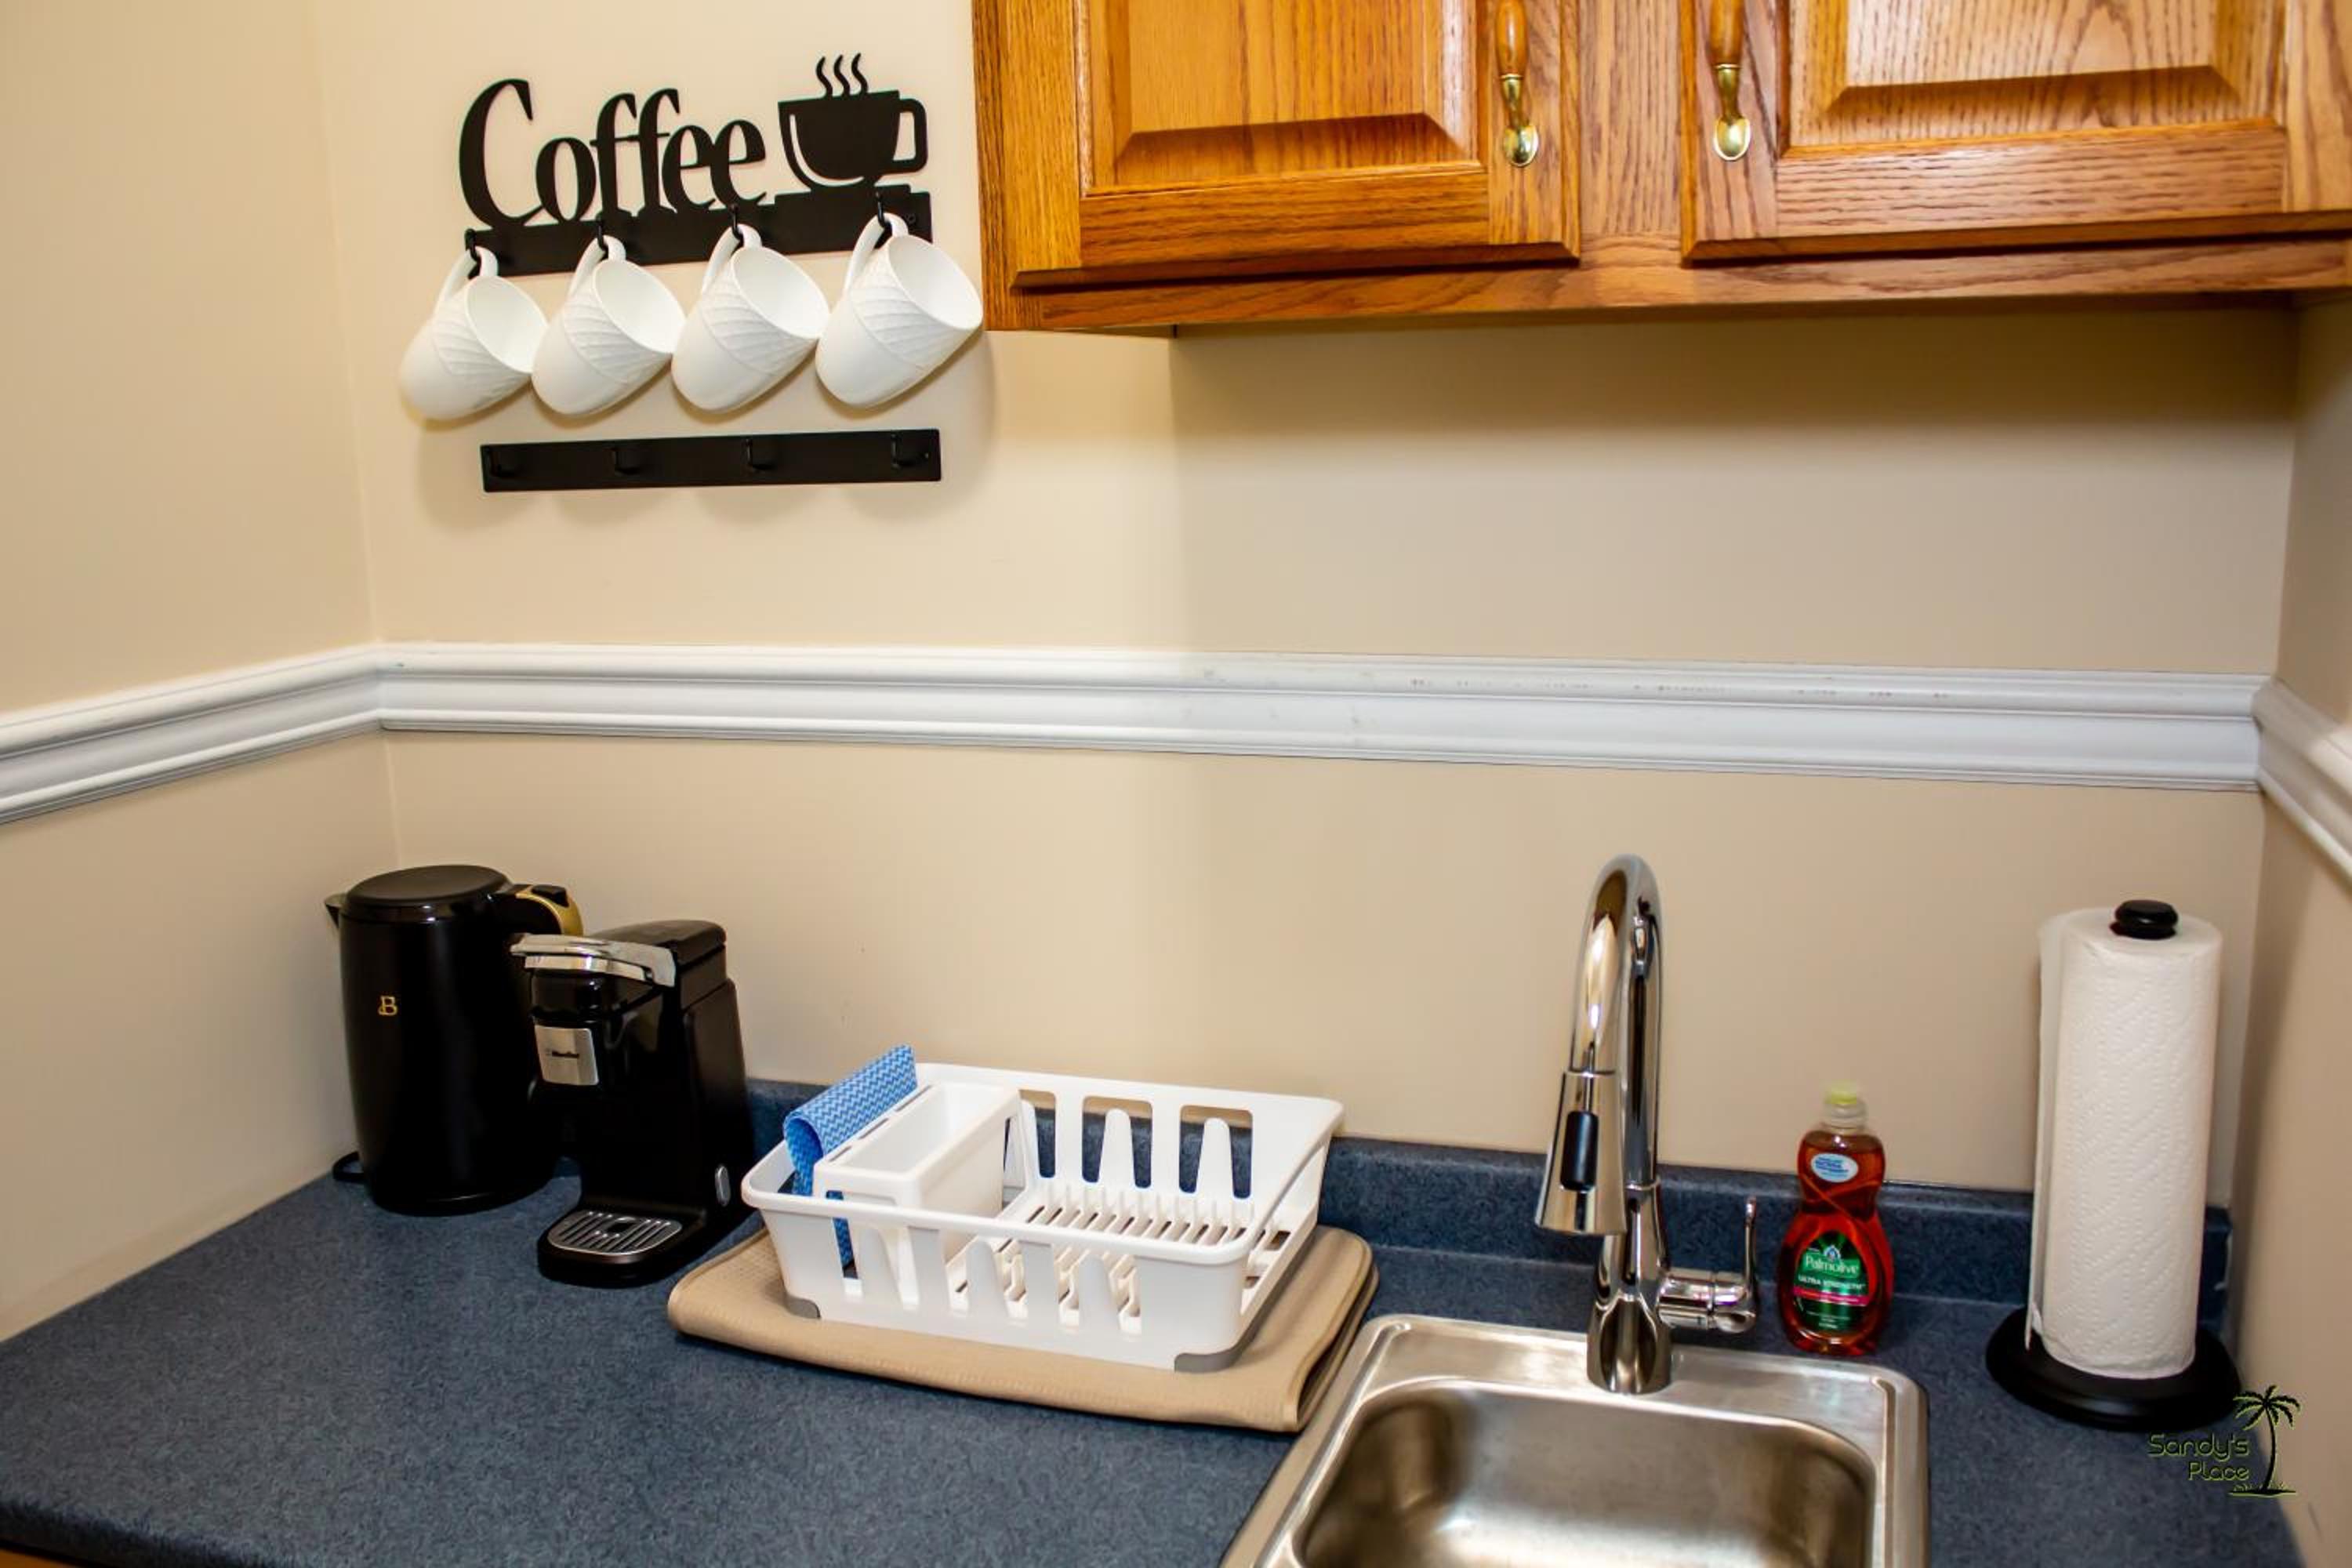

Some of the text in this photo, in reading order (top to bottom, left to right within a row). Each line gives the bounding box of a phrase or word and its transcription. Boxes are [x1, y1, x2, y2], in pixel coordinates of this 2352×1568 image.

[459, 78, 767, 227] Coffee
[378, 995, 397, 1016] B
[1805, 1254, 1859, 1275] Palmolive
[1798, 1273, 1821, 1286] ULTRA
